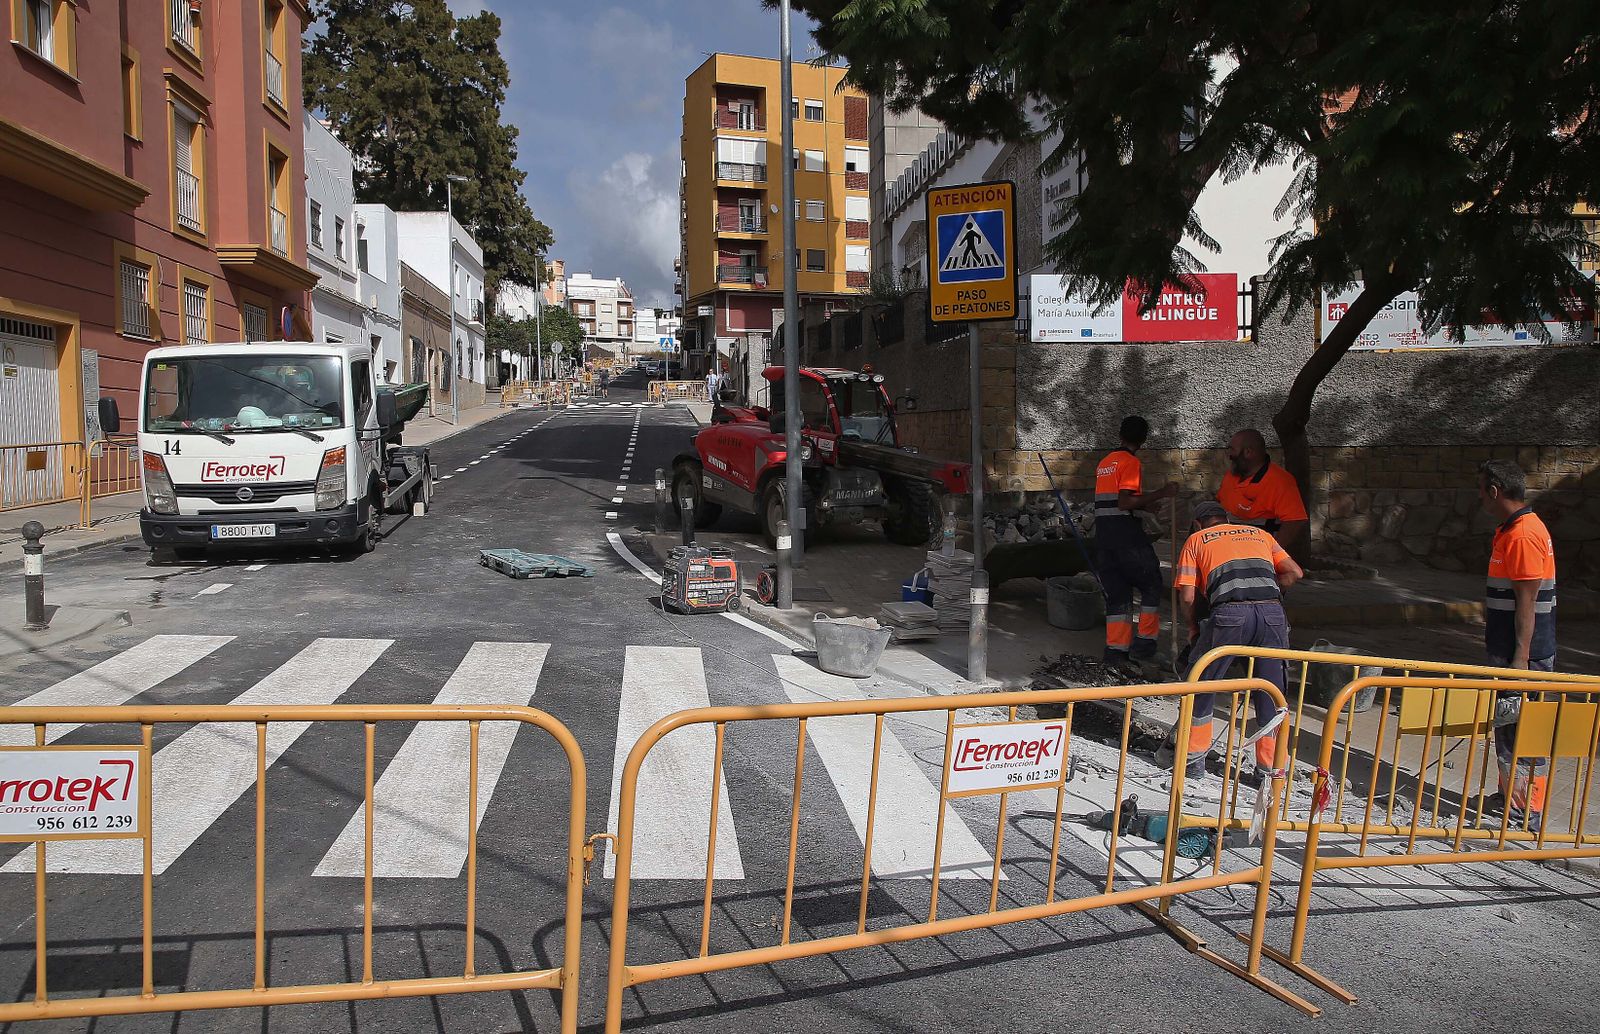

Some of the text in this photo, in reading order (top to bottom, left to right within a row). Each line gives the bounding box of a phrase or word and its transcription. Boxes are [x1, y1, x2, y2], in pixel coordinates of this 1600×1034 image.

[934, 187, 1006, 207] ATENCIÓN
[957, 289, 987, 301] PASO
[1037, 295, 1070, 306] Colegio
[935, 301, 1011, 316] DE PEATONES
[1037, 309, 1062, 318] María
[1142, 306, 1218, 321] BILINGÜE
[163, 439, 182, 456] 14
[206, 462, 279, 481] Ferrotek
[221, 525, 271, 537] 8800 FVC
[960, 738, 1053, 765] Ferrotek
[1007, 769, 1059, 783] 956 612 239
[0, 775, 119, 811] rrotek
[37, 815, 132, 830] 956 612 239
